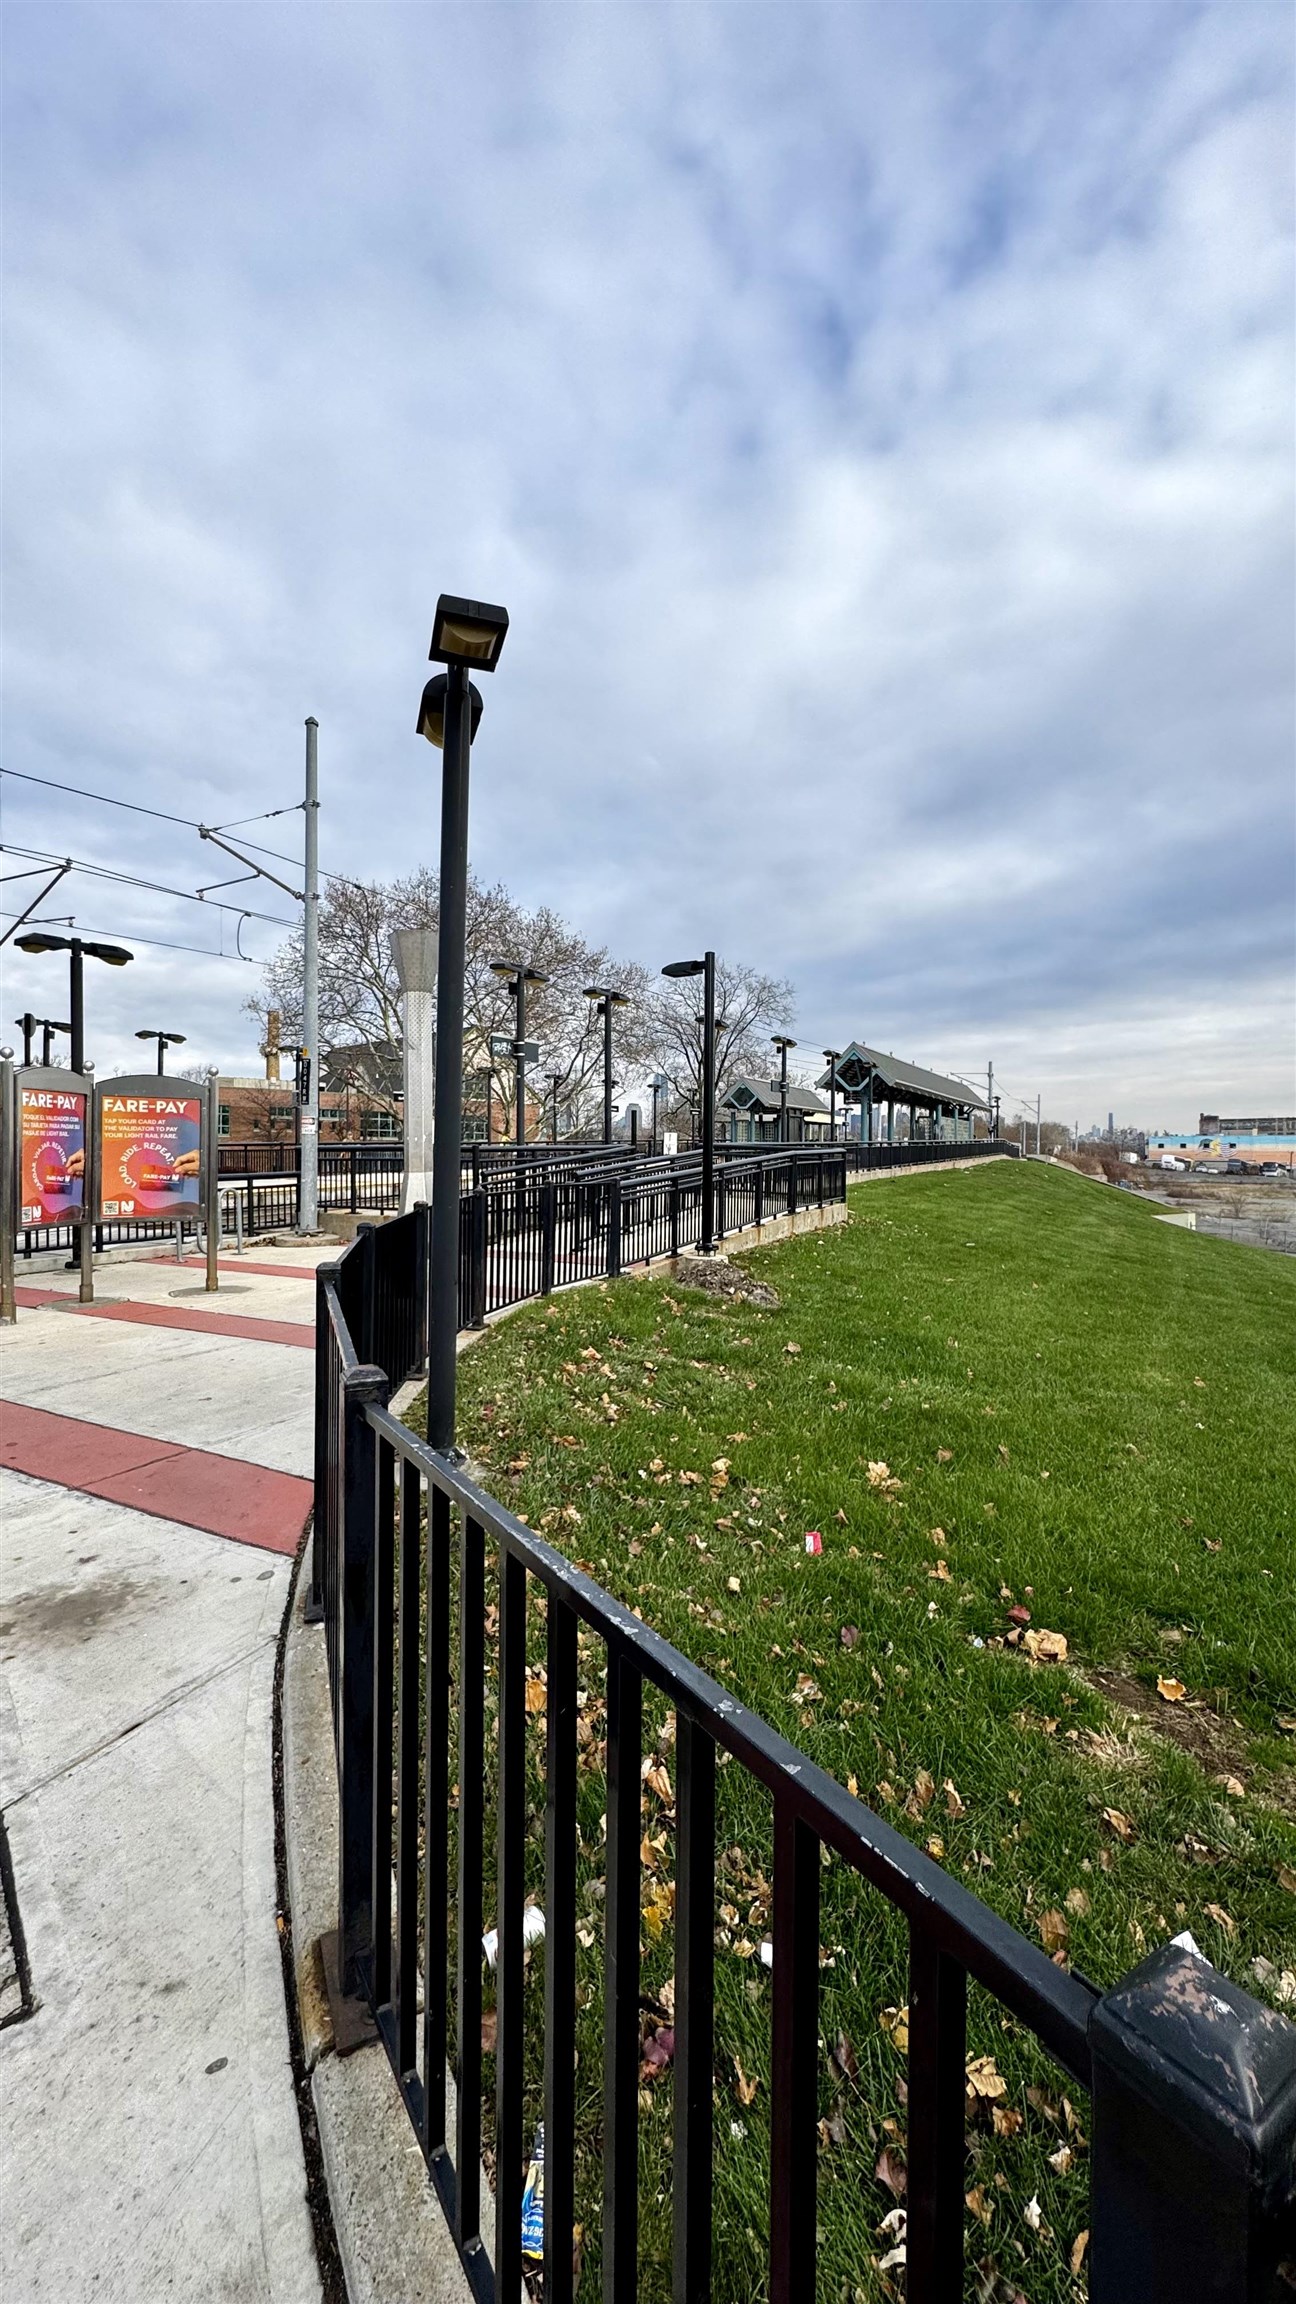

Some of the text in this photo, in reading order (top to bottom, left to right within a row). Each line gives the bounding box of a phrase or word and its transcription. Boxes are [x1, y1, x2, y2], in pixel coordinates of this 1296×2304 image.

[22, 1092, 77, 1110] FARE-PAY
[103, 1098, 188, 1114] FARE-PAY
[120, 1144, 142, 1162] RIDE.
[143, 1142, 175, 1165] REPEAT.
